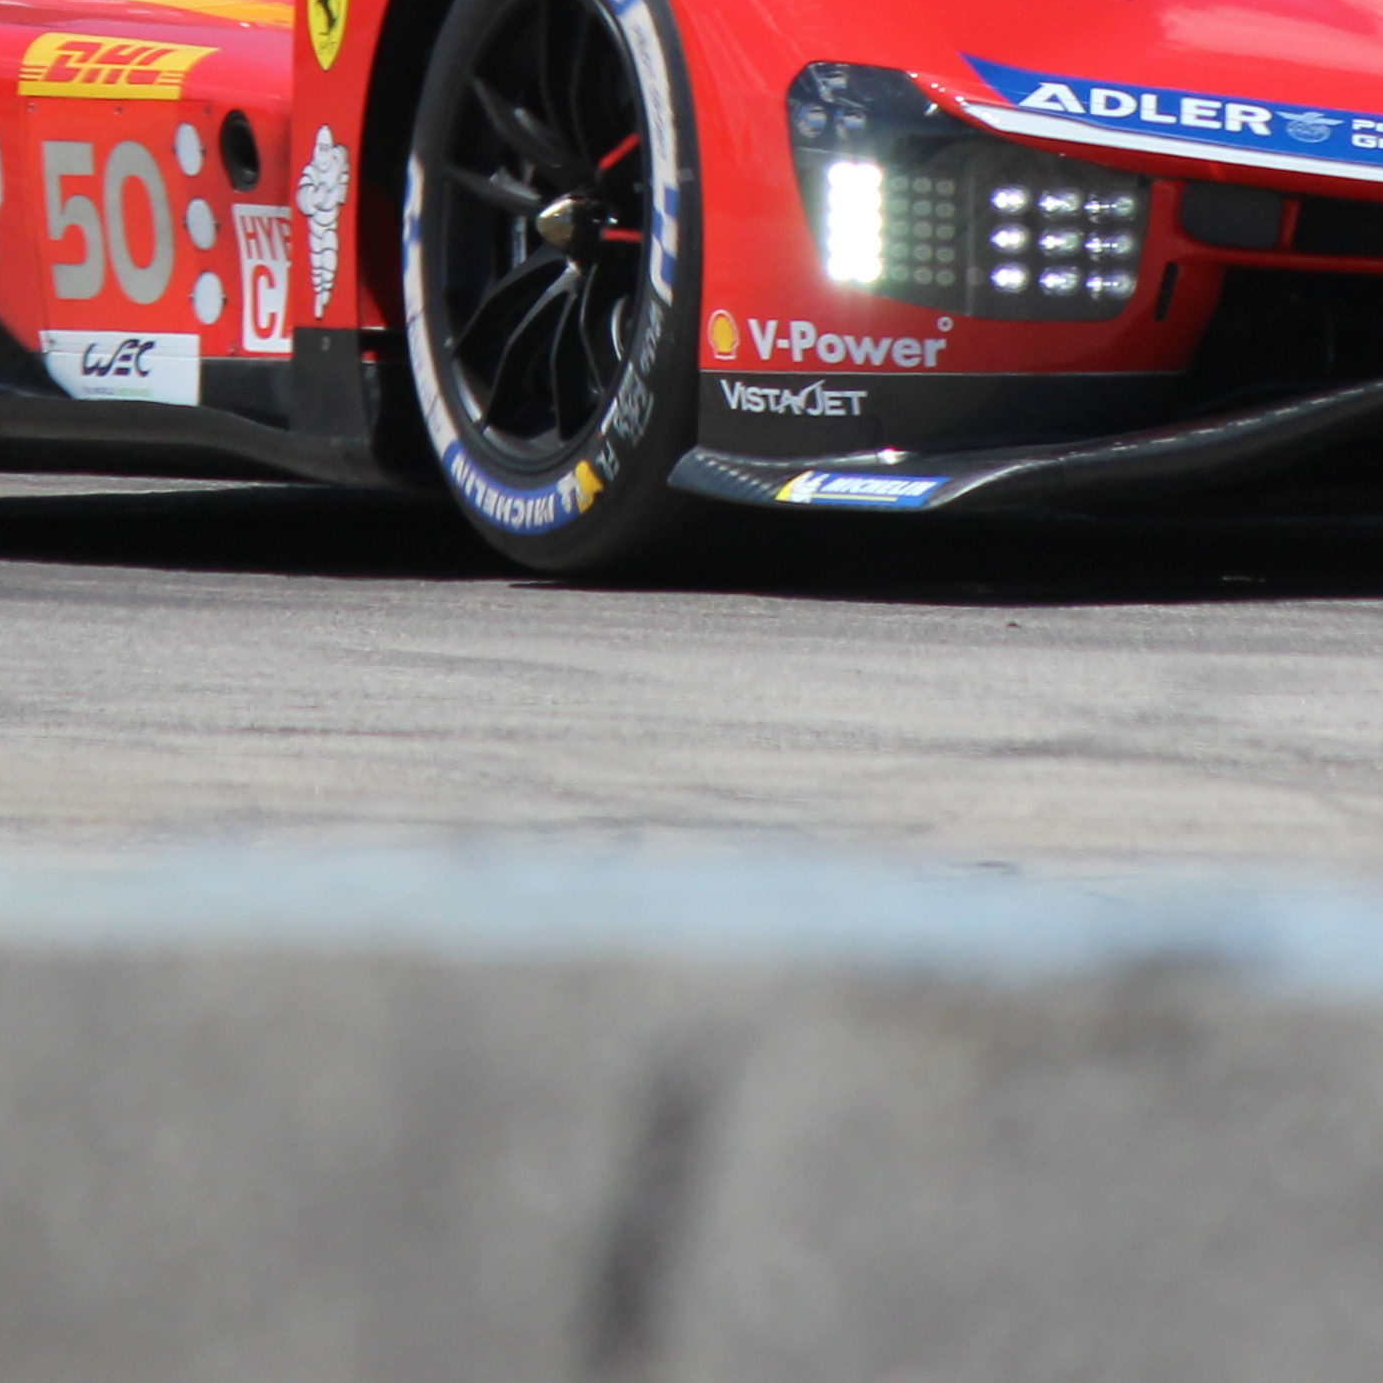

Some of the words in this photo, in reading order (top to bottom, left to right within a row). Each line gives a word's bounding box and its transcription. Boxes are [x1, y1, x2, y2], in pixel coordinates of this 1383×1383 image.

[43, 40, 179, 85] DHL
[1018, 81, 1272, 136] ADLER
[43, 140, 175, 305] 50
[252, 265, 293, 339] C
[82, 338, 155, 377] WEC
[748, 318, 947, 368] V-Power
[450, 452, 555, 529] MICHELIN
[820, 477, 939, 497] MICHELIN
